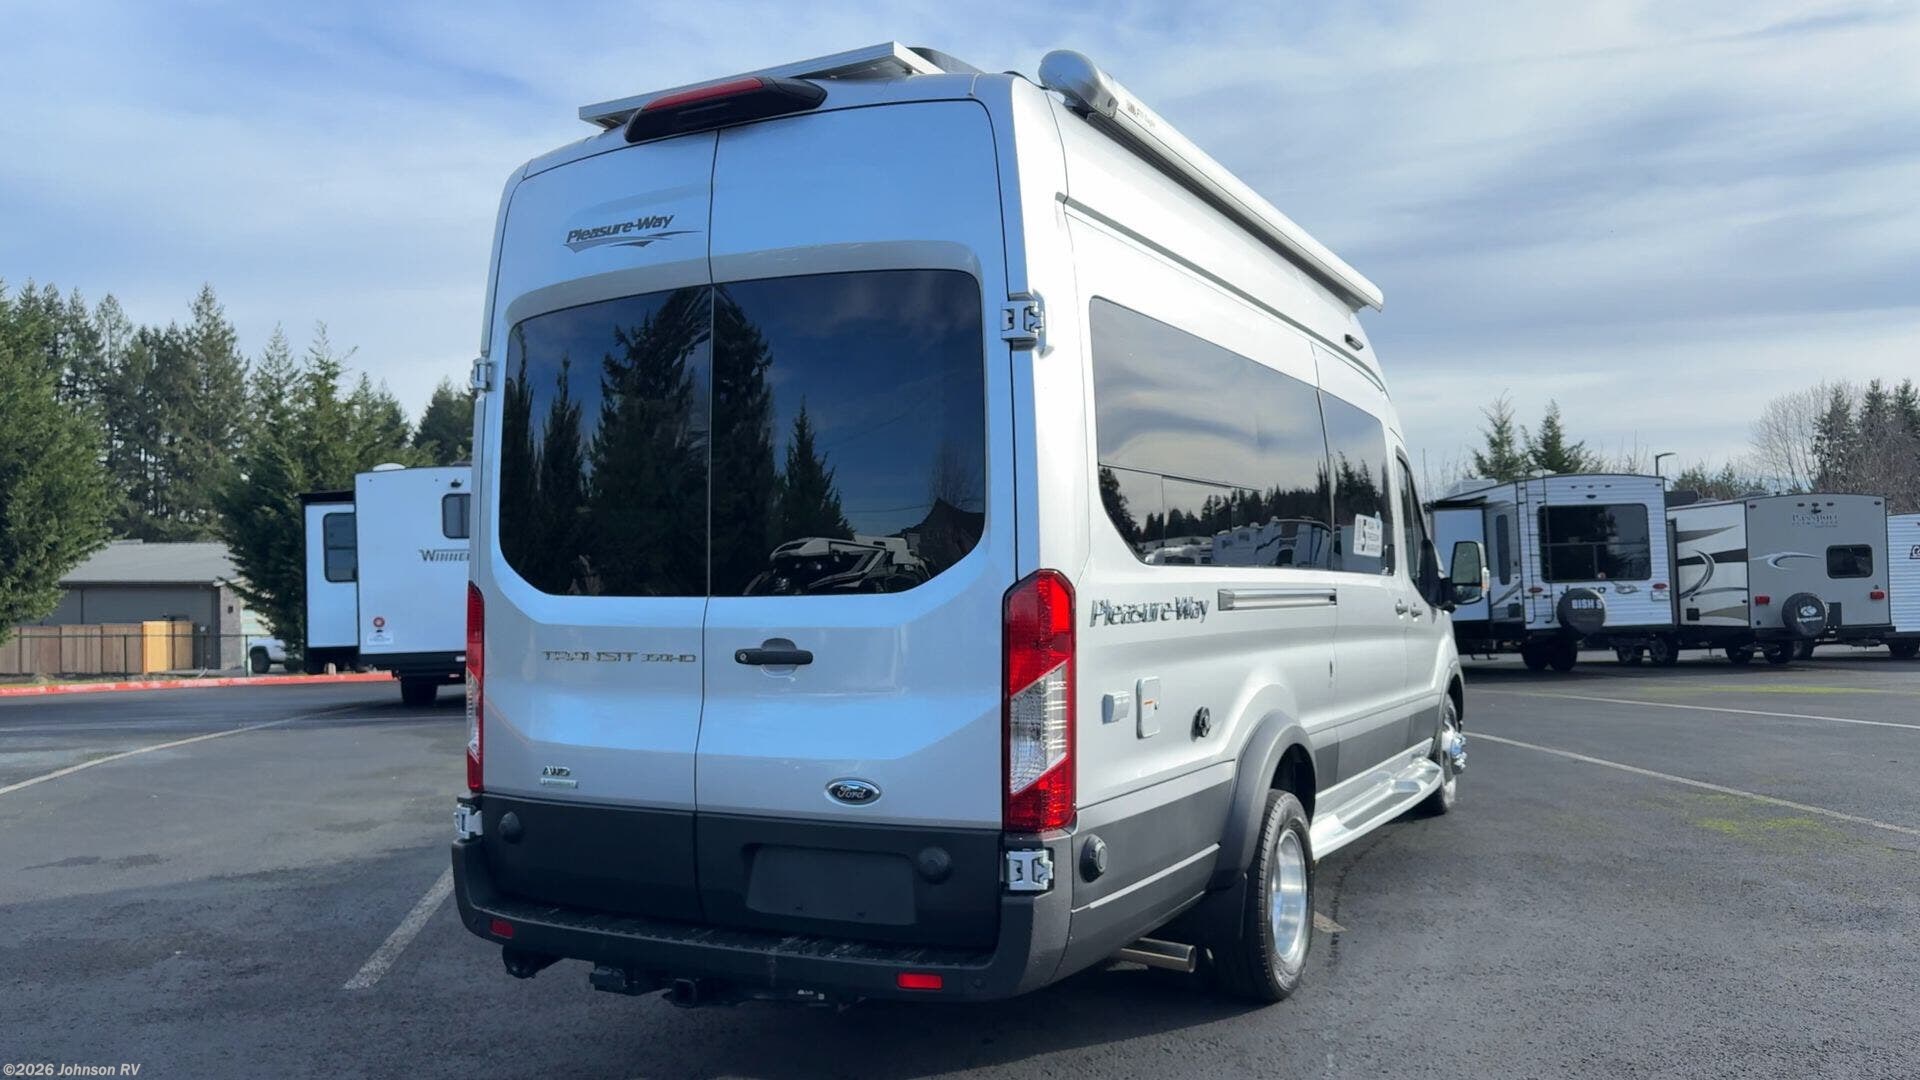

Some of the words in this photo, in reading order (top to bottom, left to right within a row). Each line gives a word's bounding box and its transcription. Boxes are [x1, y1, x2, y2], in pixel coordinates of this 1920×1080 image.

[566, 214, 675, 243] Pleasure-Way
[1089, 595, 1209, 627] Pleasure-Way
[543, 650, 638, 662] TRANSIT
[542, 765, 571, 777] AWD
[836, 785, 867, 801] Ford
